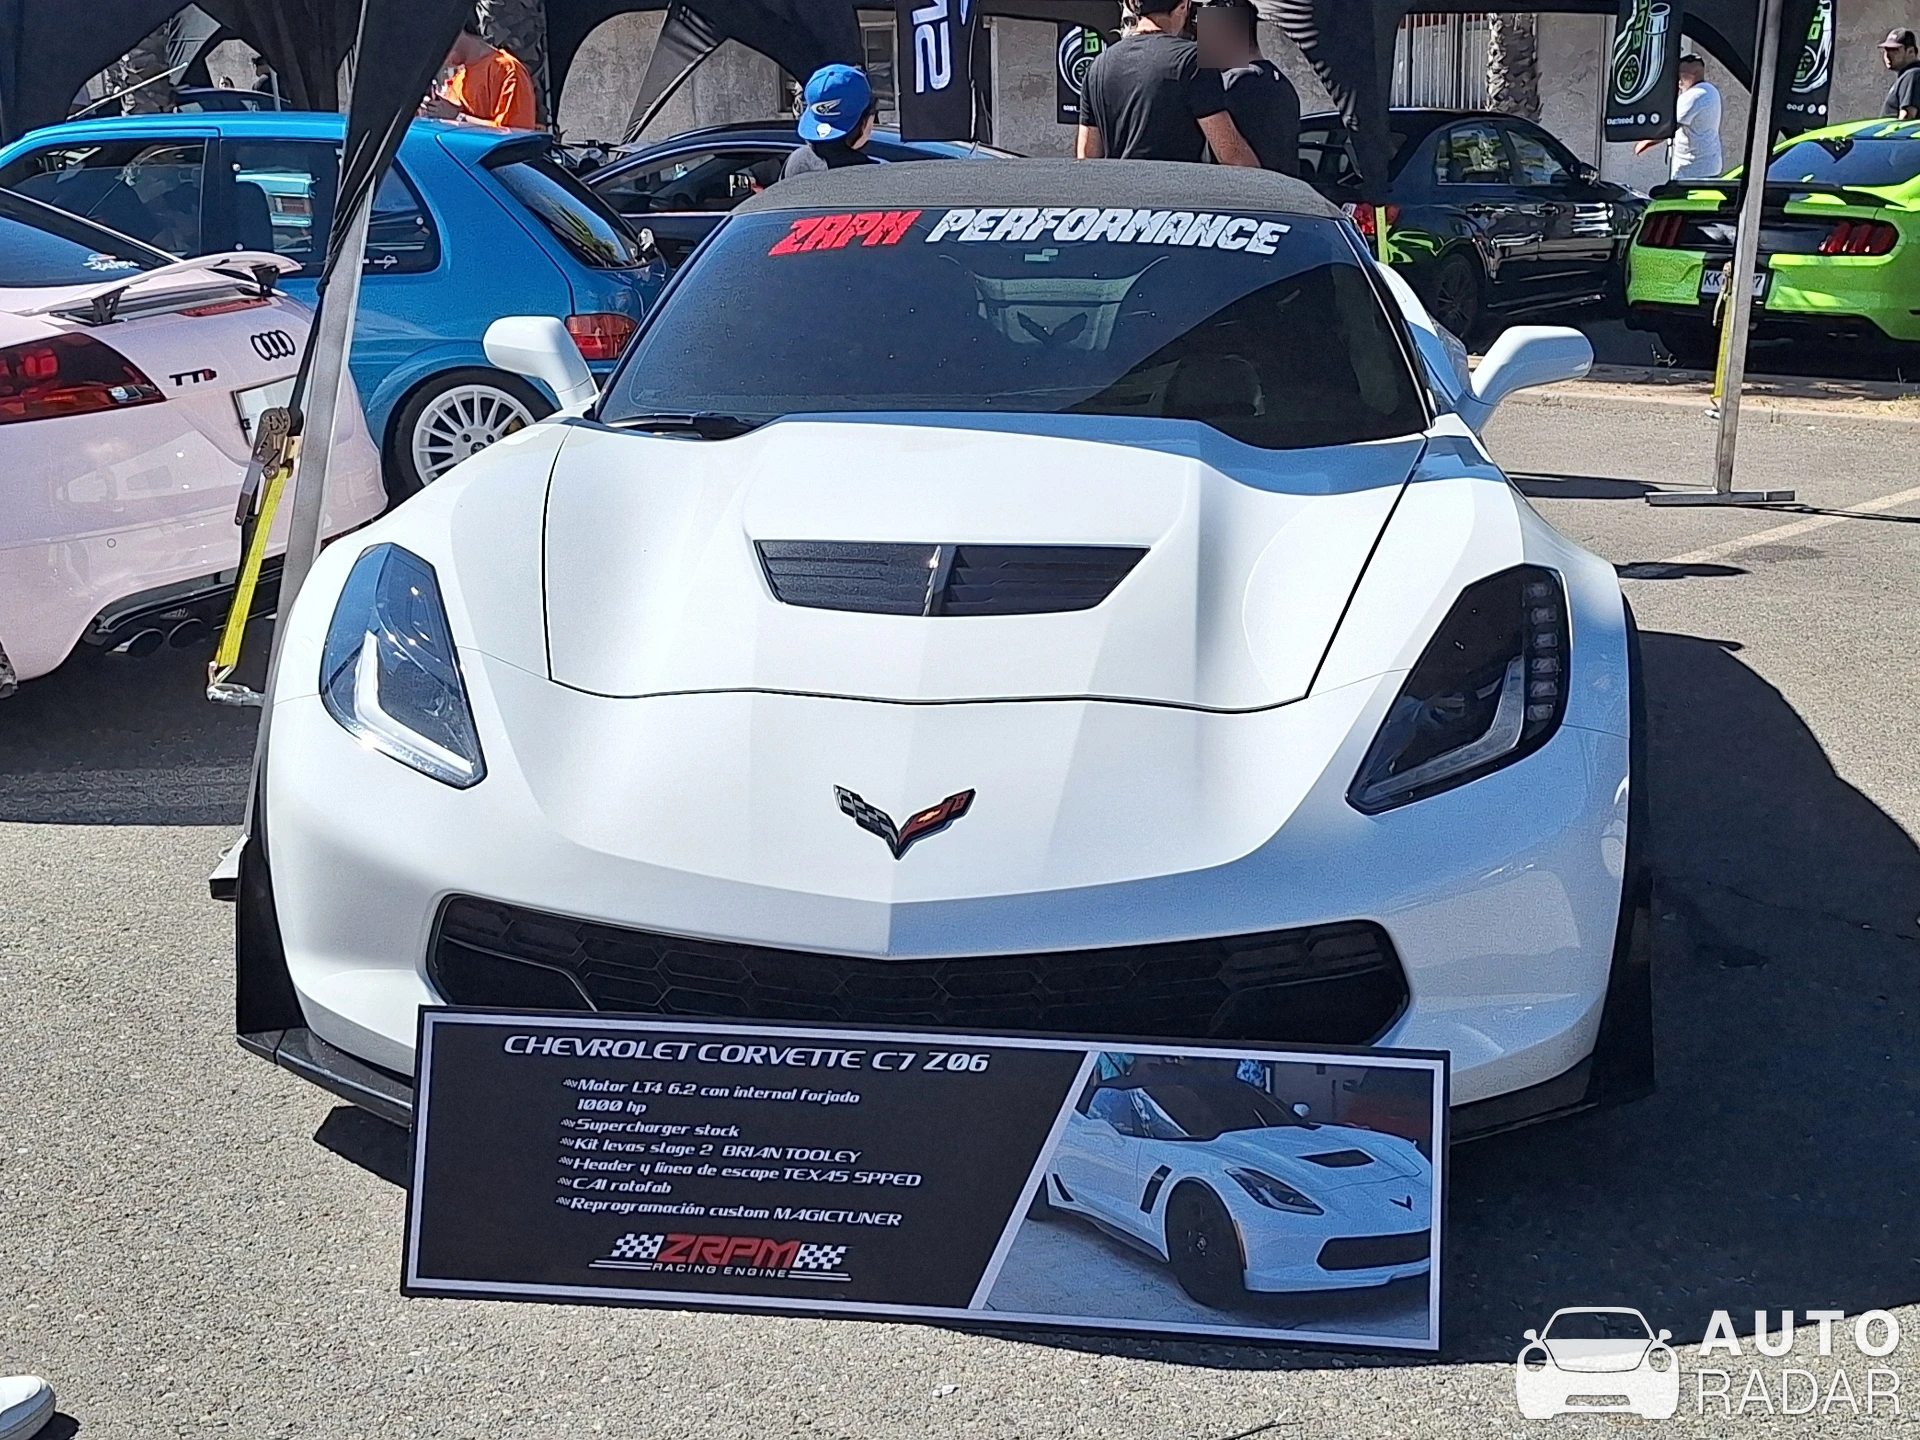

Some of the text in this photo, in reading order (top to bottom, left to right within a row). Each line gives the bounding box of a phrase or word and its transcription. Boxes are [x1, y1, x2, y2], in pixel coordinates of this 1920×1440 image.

[924, 208, 1292, 256] PERFORMANCE
[504, 1035, 990, 1072] CHEVROLET CORVETTE C7 Z06
[577, 1079, 860, 1105] Motor LT4 6.2 con internal forjado
[577, 1098, 647, 1116] 1000 hp
[575, 1118, 740, 1137] Supercharger stock
[574, 1137, 862, 1163] Kit levas stage 2 BRIAN TOOLEY
[572, 1157, 636, 1172] Header
[639, 1163, 651, 1176] y
[697, 1163, 718, 1176] de
[721, 1168, 780, 1181] escape
[784, 1167, 850, 1182] TEXAS
[852, 1171, 922, 1186] SPPED
[572, 1177, 672, 1194] CAI rotofab
[568, 1197, 902, 1226] Reprogramación custom MAGICTUNER
[656, 1233, 801, 1269] ZRPM
[652, 1262, 787, 1278] RACING ENGINE
